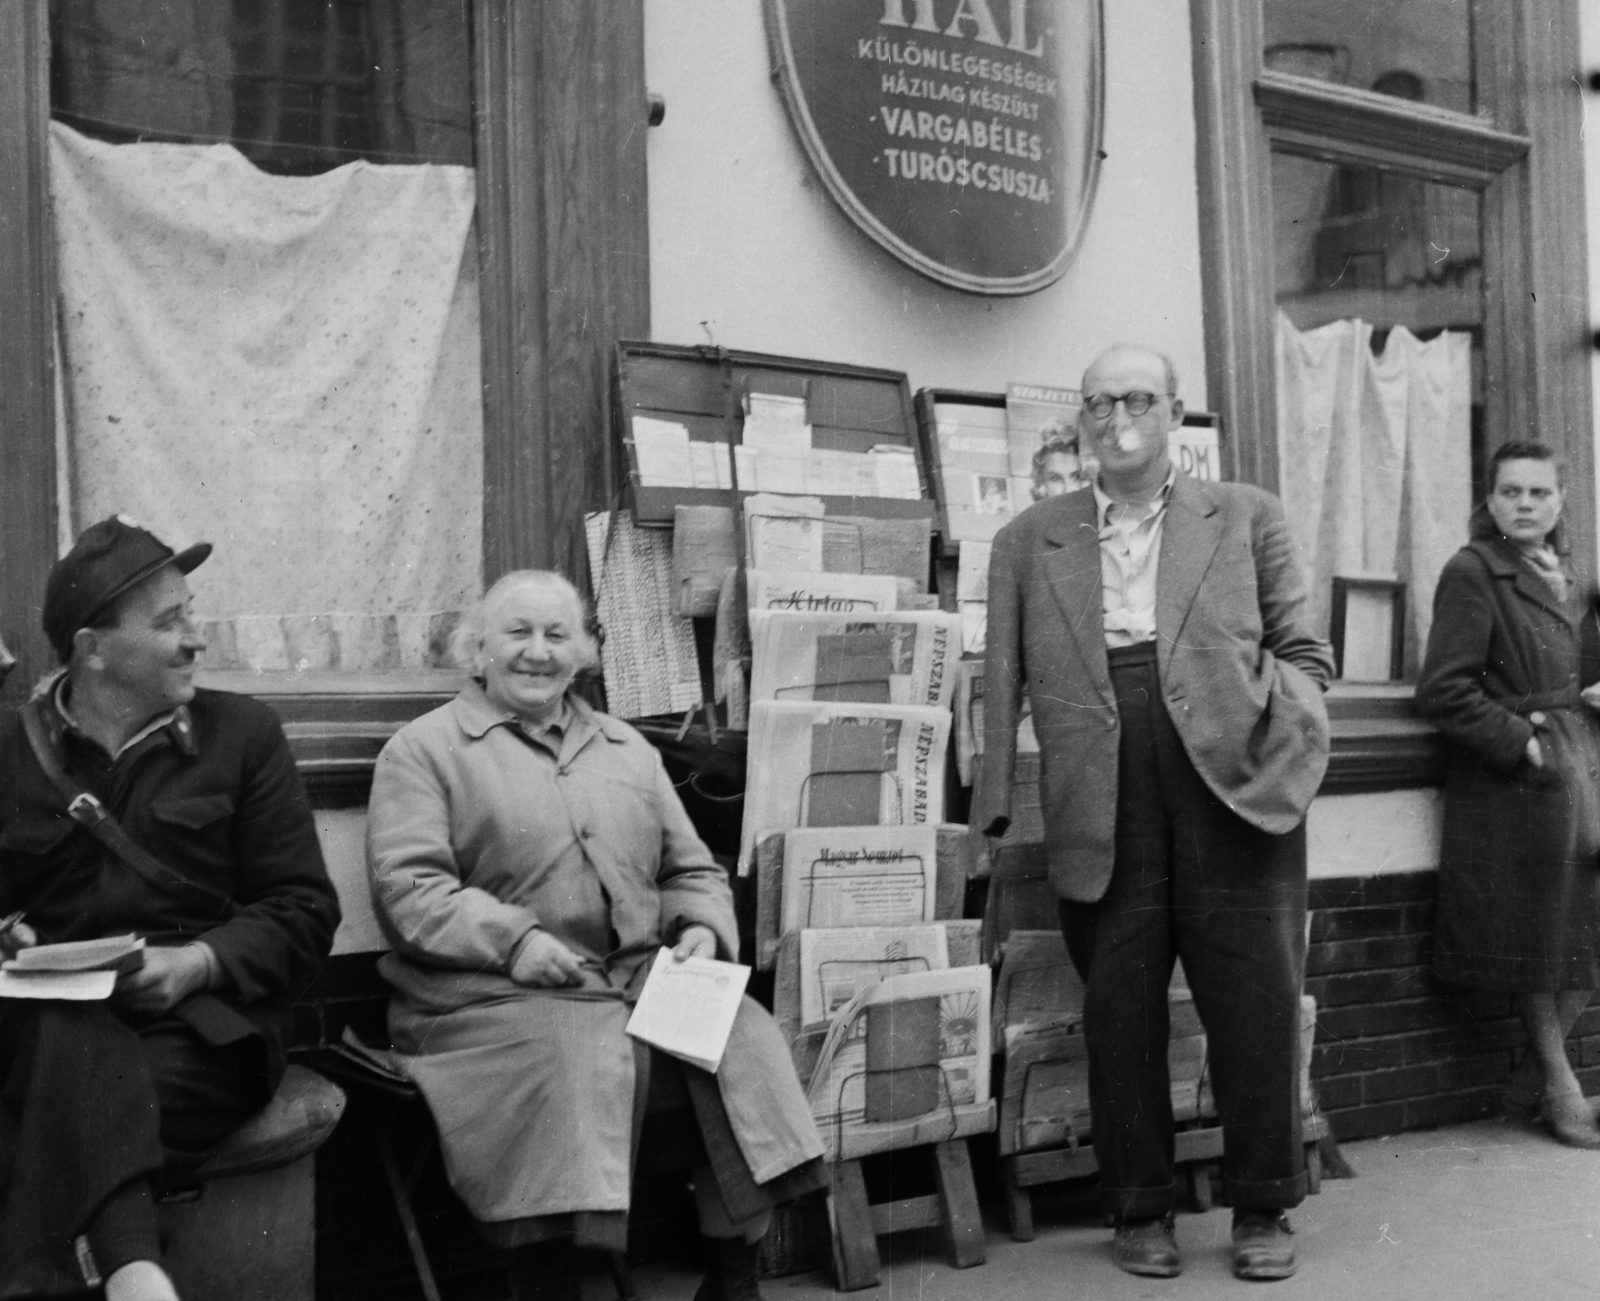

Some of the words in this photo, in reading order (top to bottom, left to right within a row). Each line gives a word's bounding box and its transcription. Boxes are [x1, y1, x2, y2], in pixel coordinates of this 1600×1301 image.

[881, 68, 966, 103] HÁZILAG
[880, 106, 1041, 161] VARGABÉLES
[883, 147, 1050, 204] TURÓSCSUSZA
